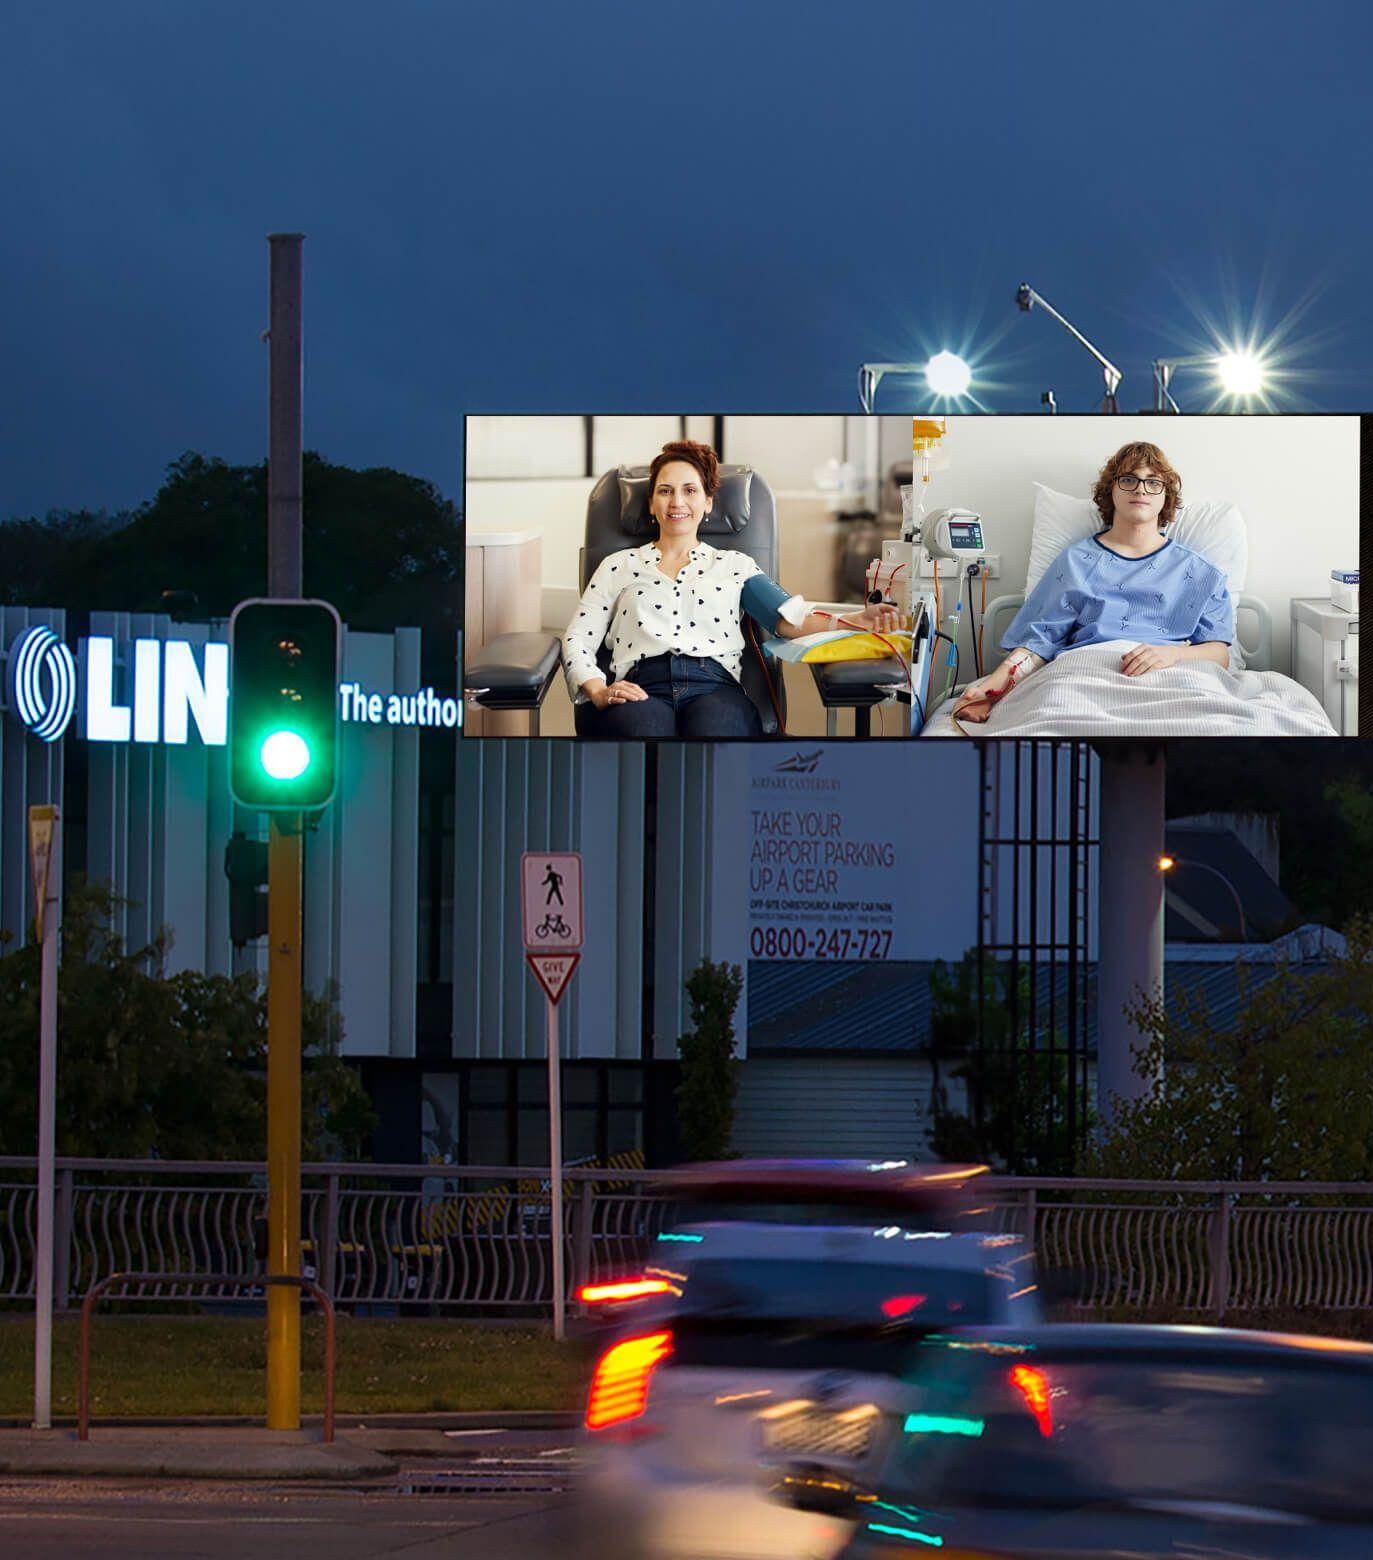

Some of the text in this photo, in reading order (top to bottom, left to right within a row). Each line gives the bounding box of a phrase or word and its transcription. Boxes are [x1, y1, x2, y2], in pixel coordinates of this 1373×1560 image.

[87, 636, 229, 746] LIN
[340, 682, 383, 723] The
[752, 811, 841, 838] TAKE YOUR
[751, 839, 895, 868] AIRPORT PARKING
[751, 867, 838, 894] UP A GEAR
[751, 927, 893, 960] 0800-247-727
[543, 961, 564, 973] GIVE
